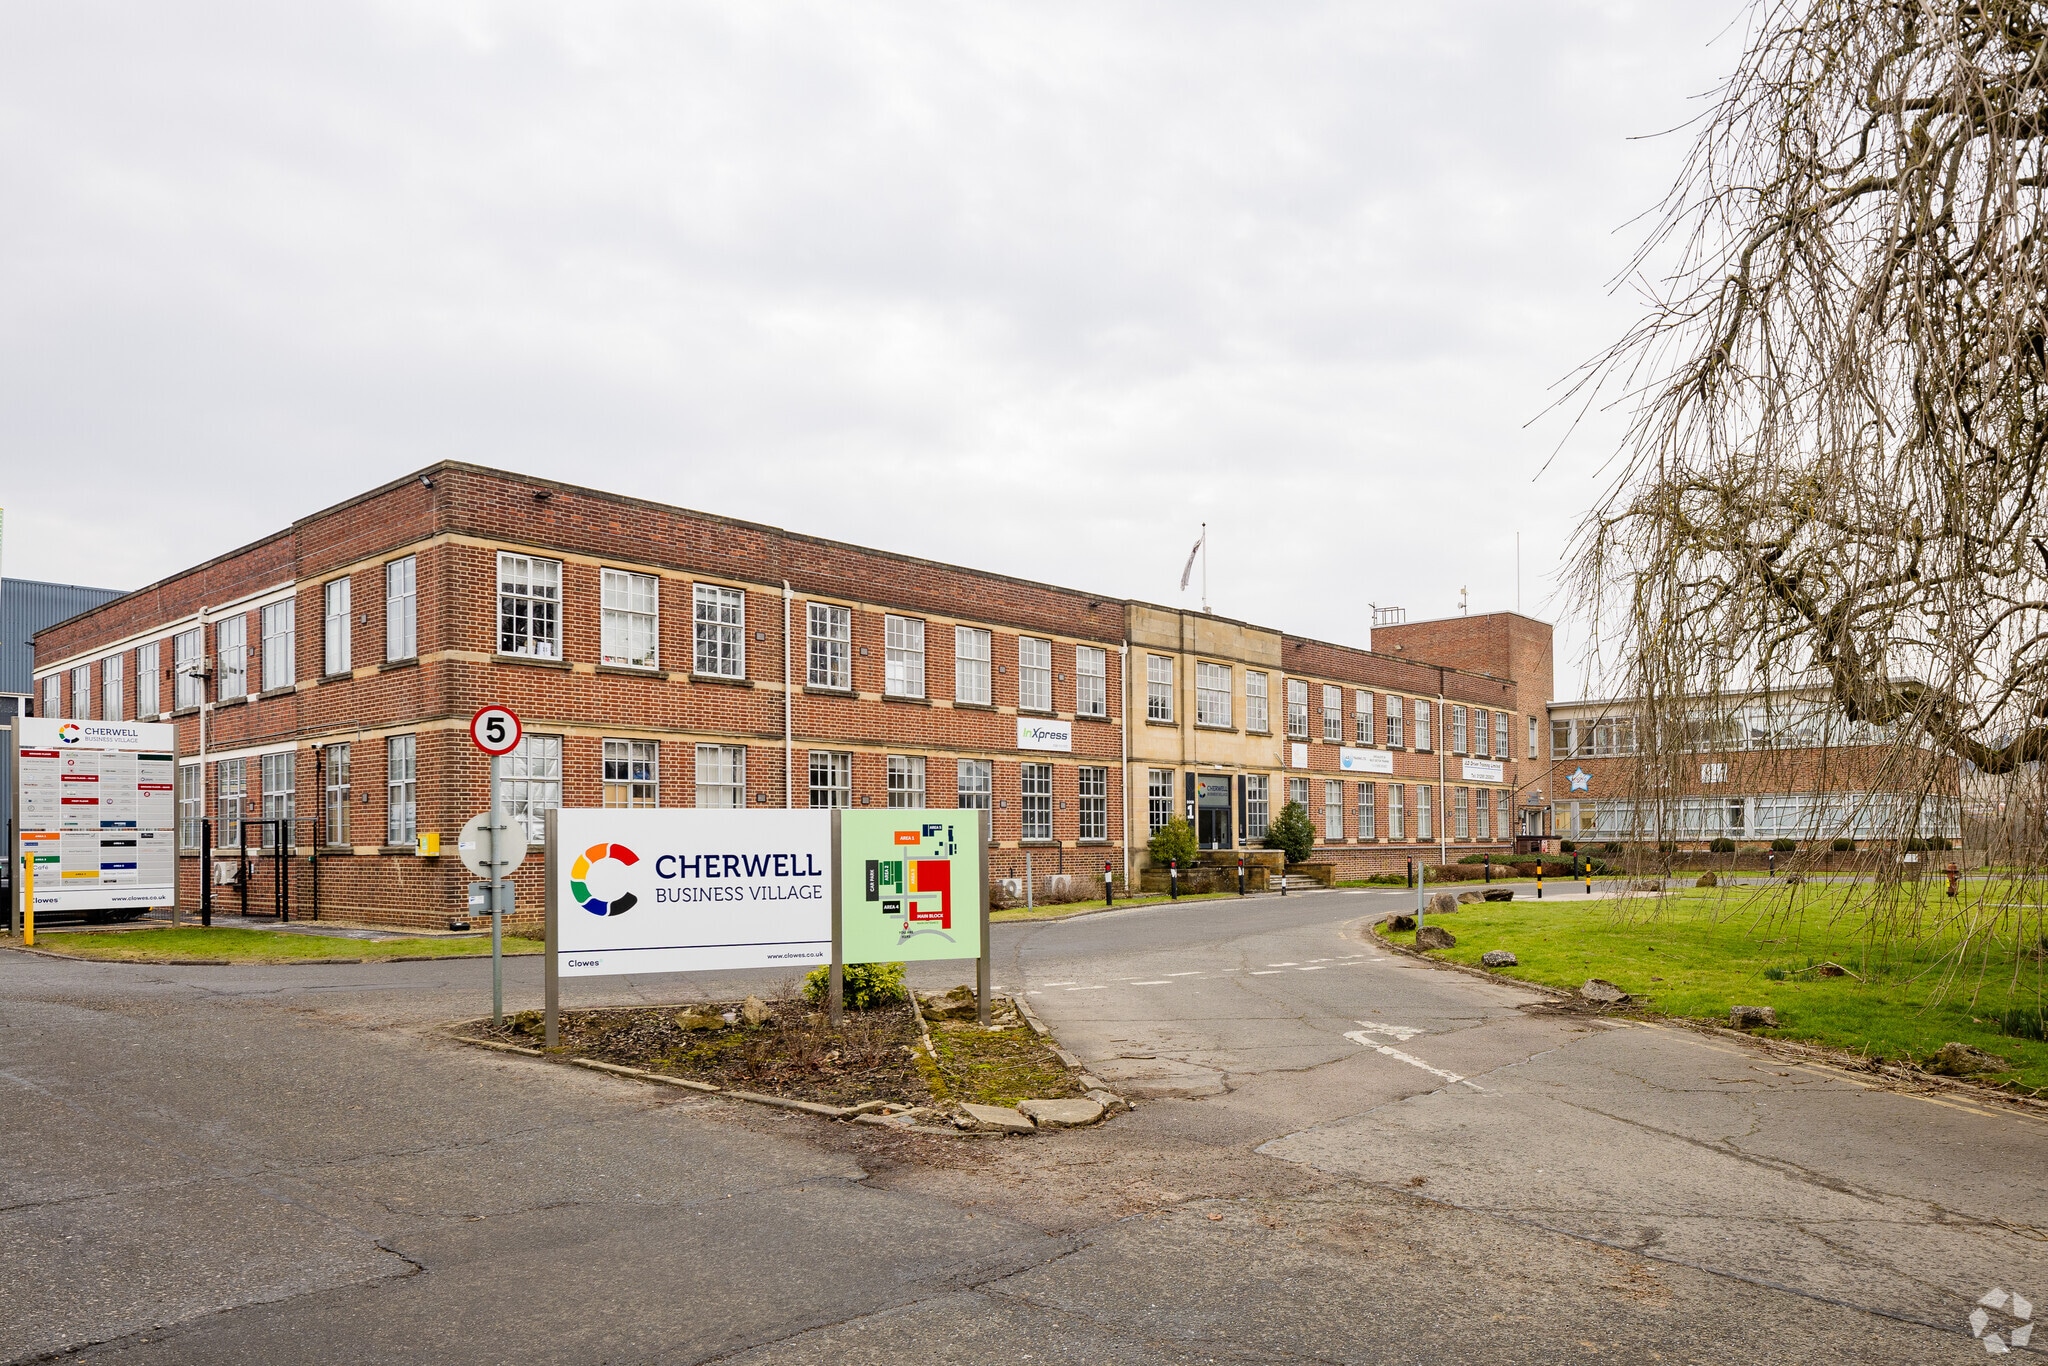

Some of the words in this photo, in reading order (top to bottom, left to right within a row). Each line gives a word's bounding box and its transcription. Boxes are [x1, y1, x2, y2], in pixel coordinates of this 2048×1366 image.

[84, 727, 139, 737] CHERWELL
[486, 716, 506, 744] 5
[1023, 727, 1068, 742] InXpress
[1187, 804, 1194, 819] 1
[655, 854, 823, 880] CHERWELL
[111, 894, 166, 902] www.clowes.co.uk
[655, 886, 744, 903] BUSINESS
[749, 884, 823, 900] VILLAGE
[767, 951, 824, 960] www.clowes.co.uk
[568, 959, 600, 968] Clowes
